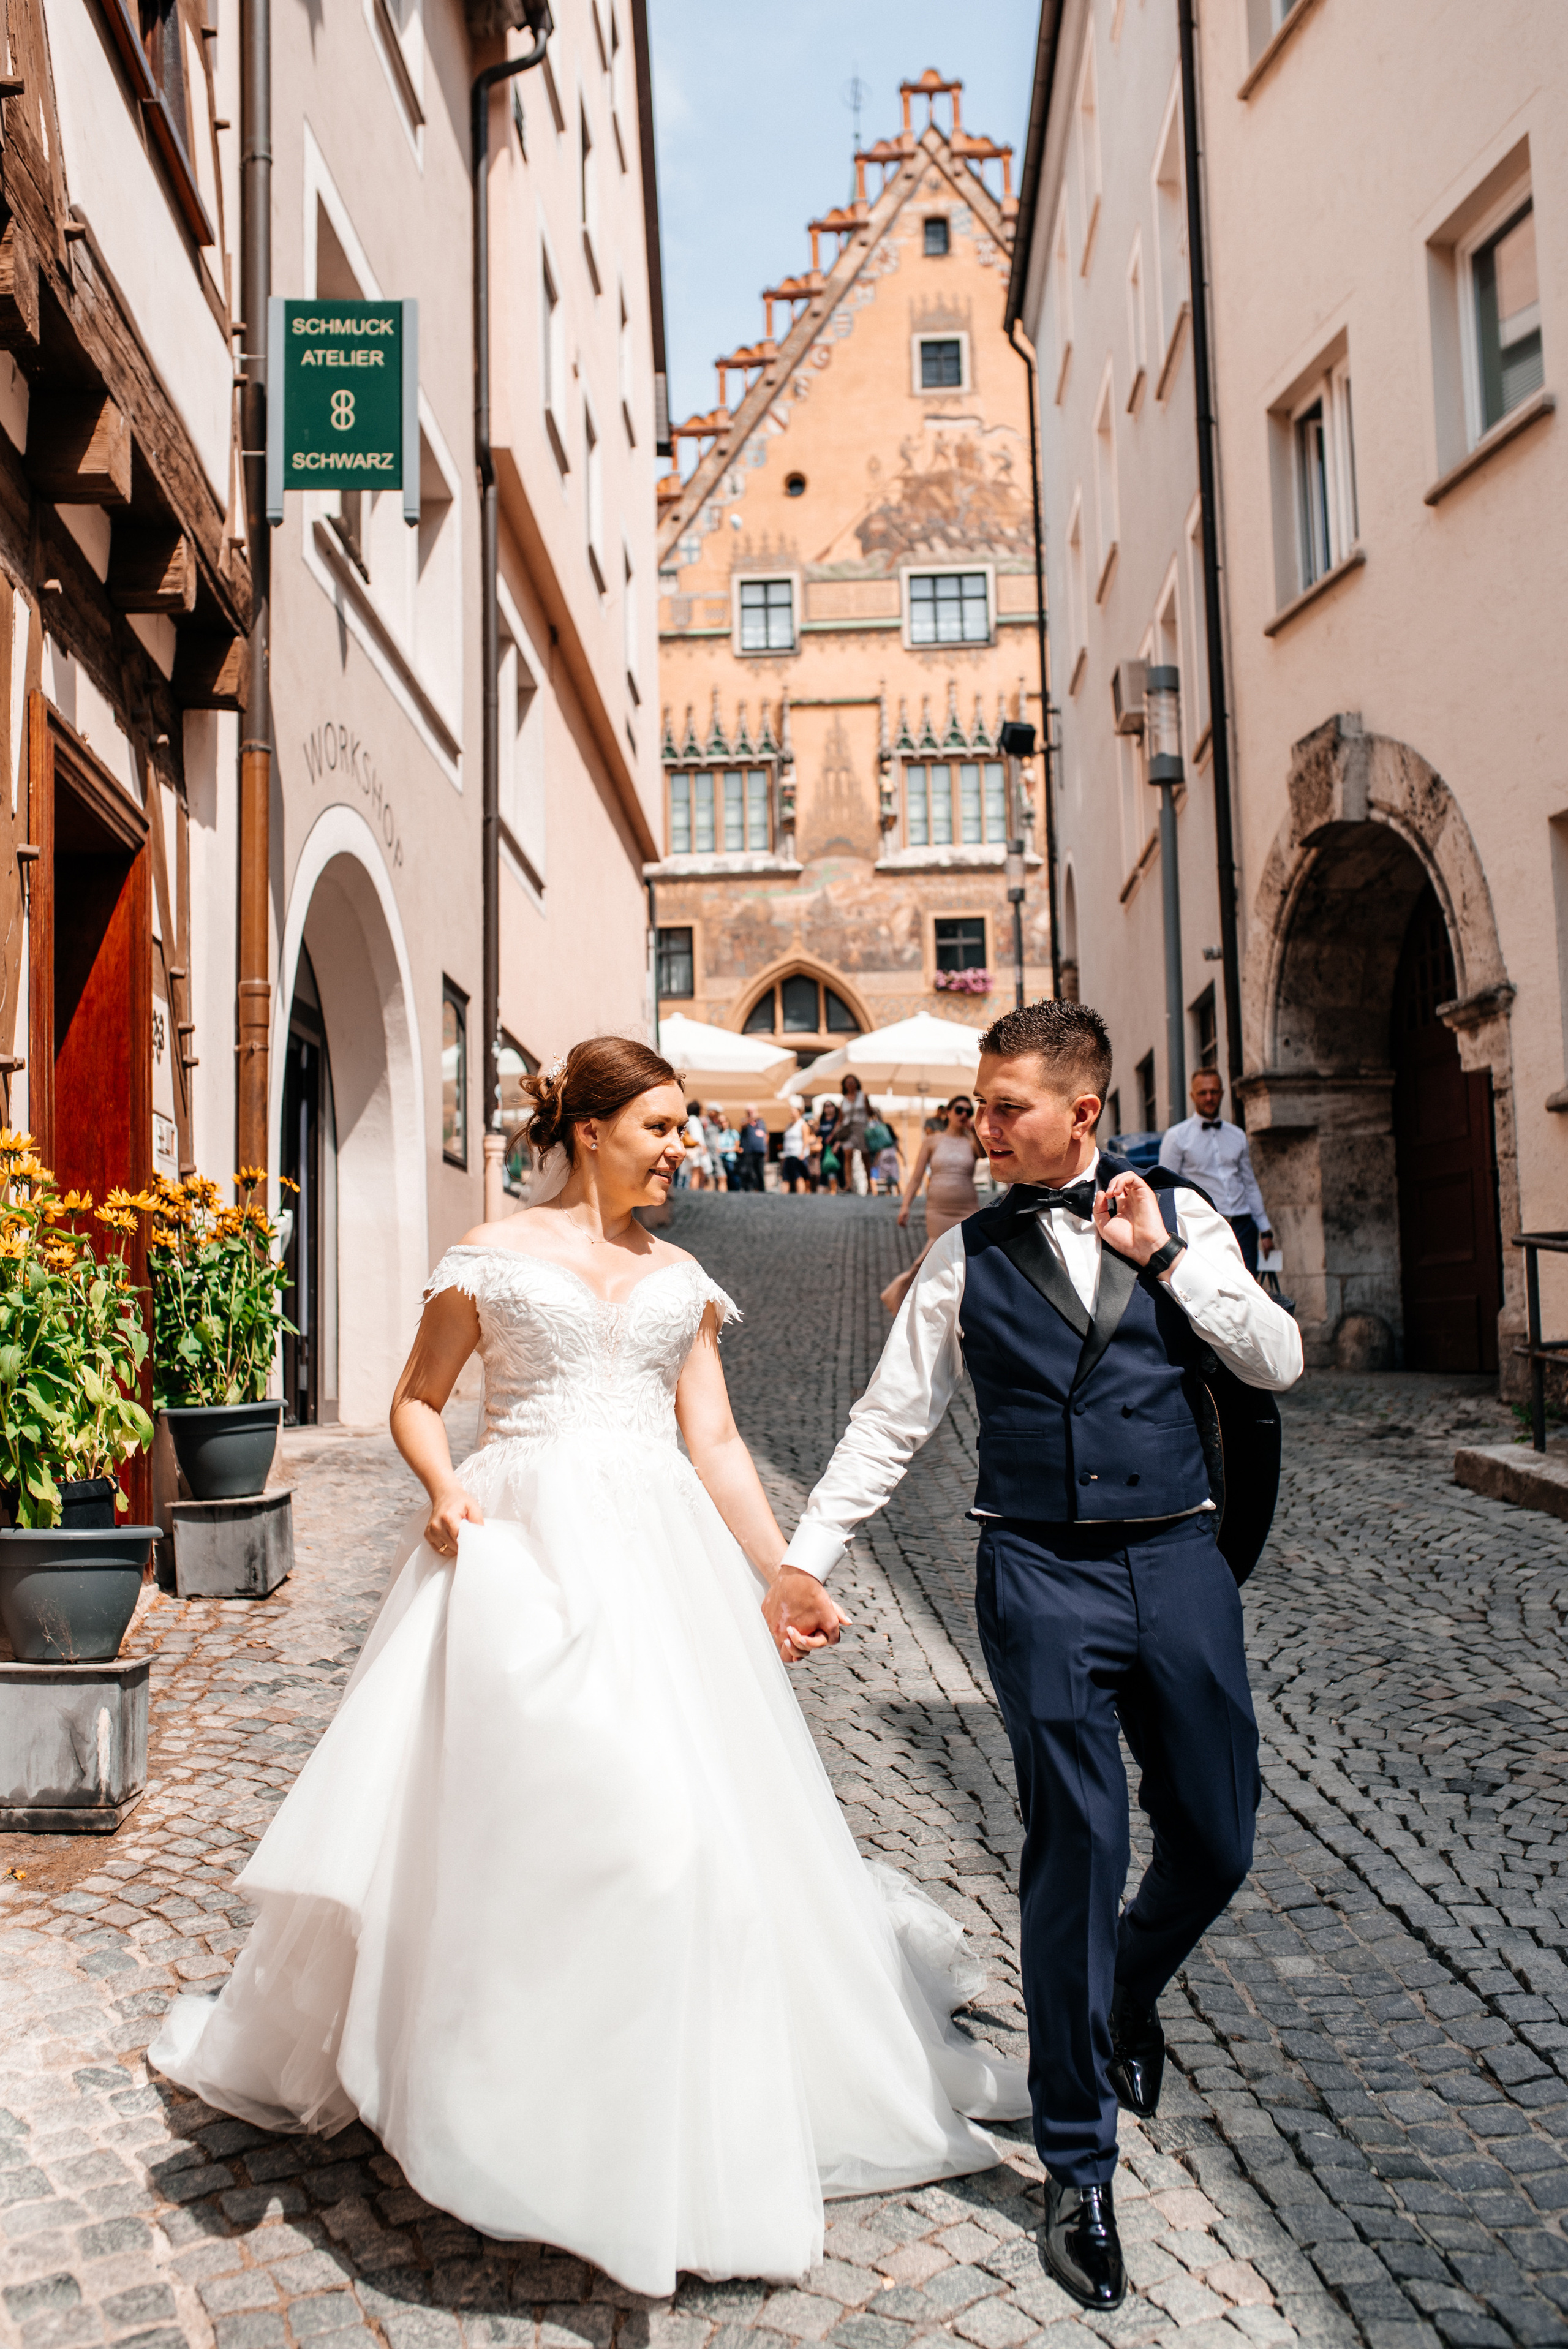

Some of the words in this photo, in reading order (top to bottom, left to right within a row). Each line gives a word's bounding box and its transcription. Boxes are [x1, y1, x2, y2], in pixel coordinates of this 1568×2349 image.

[292, 317, 394, 336] SCHMUCK
[301, 349, 385, 367] ATELIER
[292, 452, 394, 470] SCHWARZ
[303, 721, 404, 868] WORKSHOP
